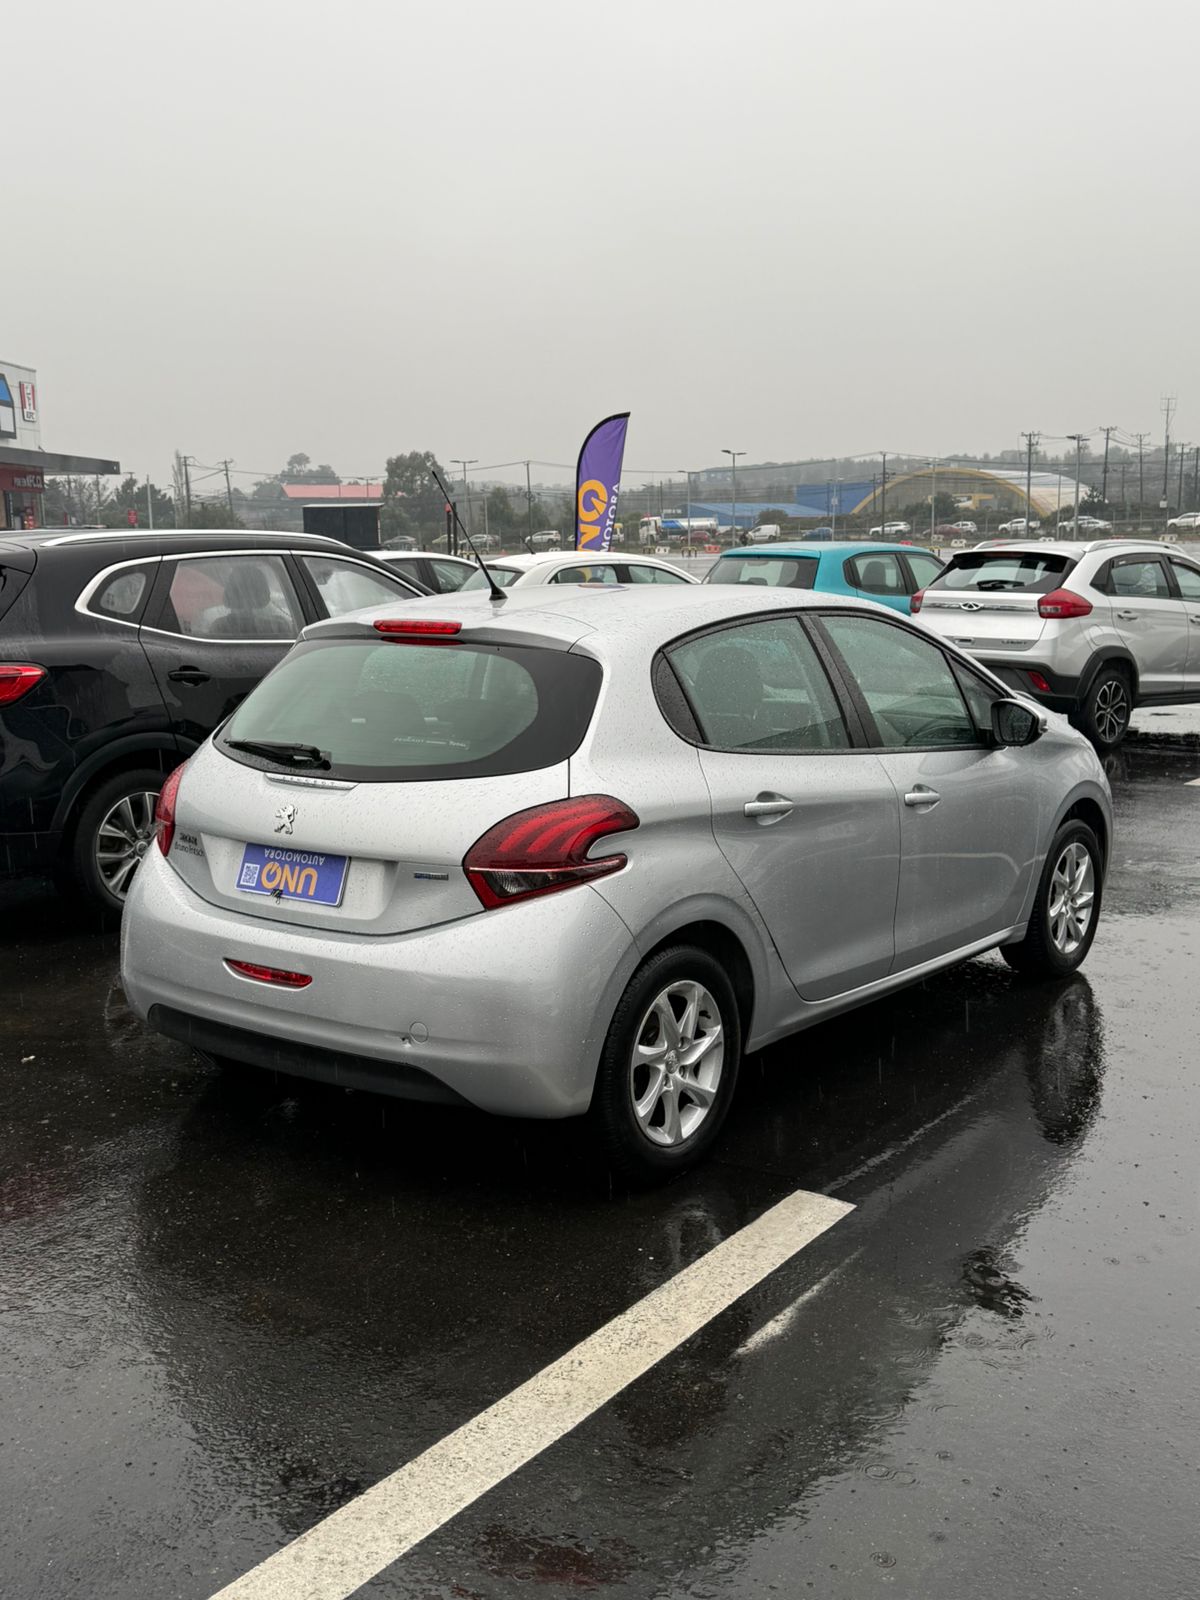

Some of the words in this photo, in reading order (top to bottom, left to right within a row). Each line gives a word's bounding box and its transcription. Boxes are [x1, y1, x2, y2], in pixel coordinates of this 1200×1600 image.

[577, 479, 608, 552] NO
[600, 483, 620, 552] MOTORA
[261, 861, 318, 896] UNO
[264, 848, 326, 866] AUTOMOTORA
